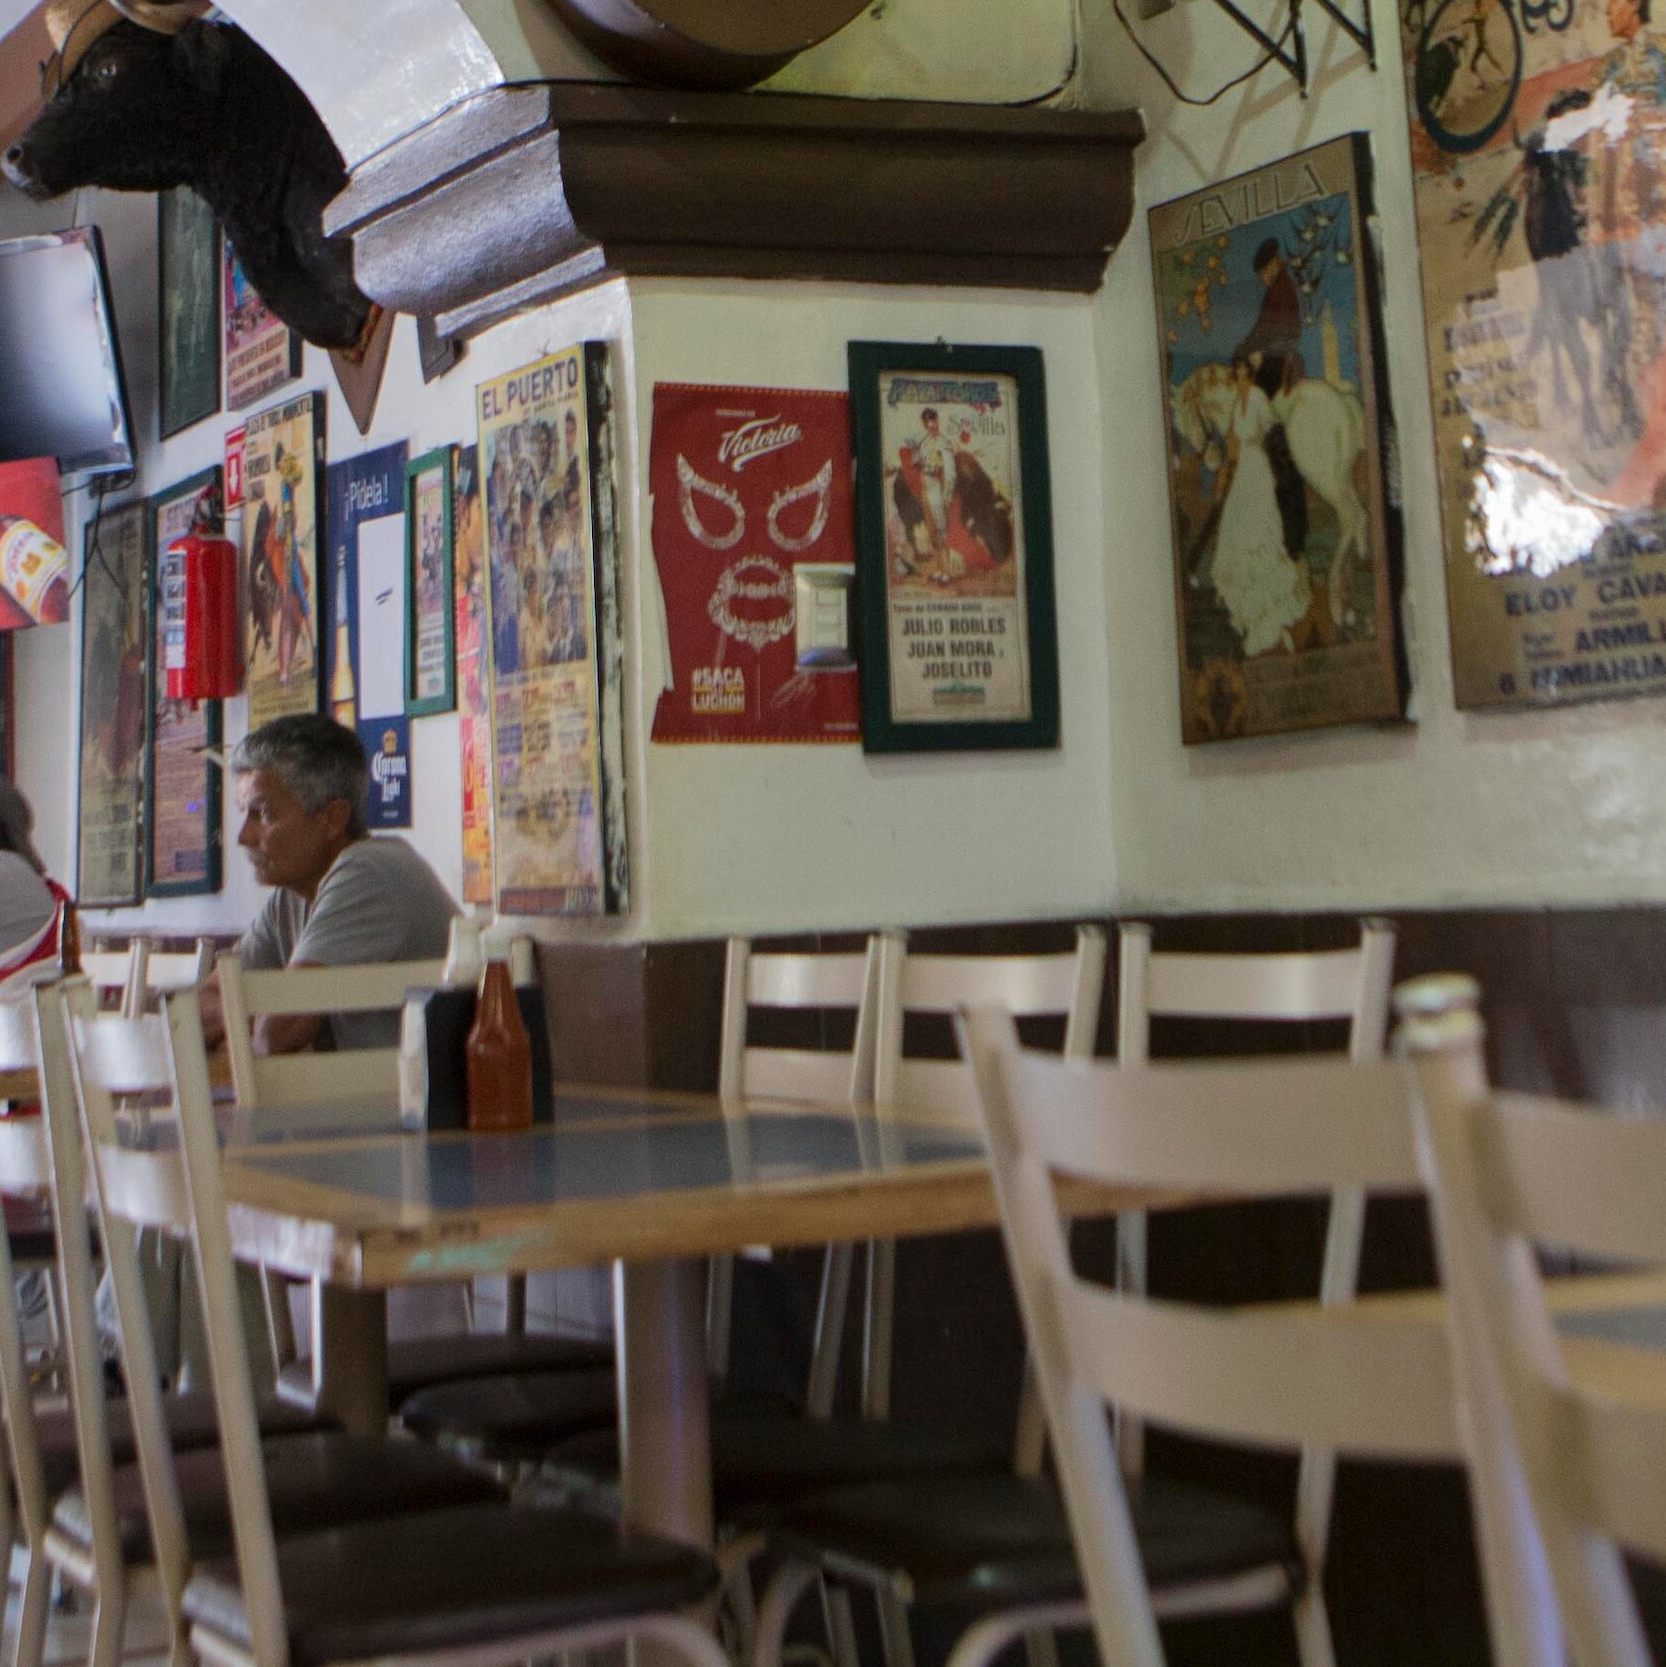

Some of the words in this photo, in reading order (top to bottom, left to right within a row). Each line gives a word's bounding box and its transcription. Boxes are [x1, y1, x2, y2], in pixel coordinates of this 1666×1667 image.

[1179, 162, 1330, 243] SEVILLA
[482, 387, 503, 420] EL
[507, 356, 579, 411] PUERTO
[718, 413, 803, 472] Victoria
[1505, 585, 1575, 616] ELOY
[903, 618, 944, 636] JULIO
[950, 618, 1006, 635] ROBLES
[909, 640, 945, 658] JUAN
[950, 640, 995, 658] MORA
[923, 662, 993, 679] JOSELITO
[371, 750, 407, 782] Corona
